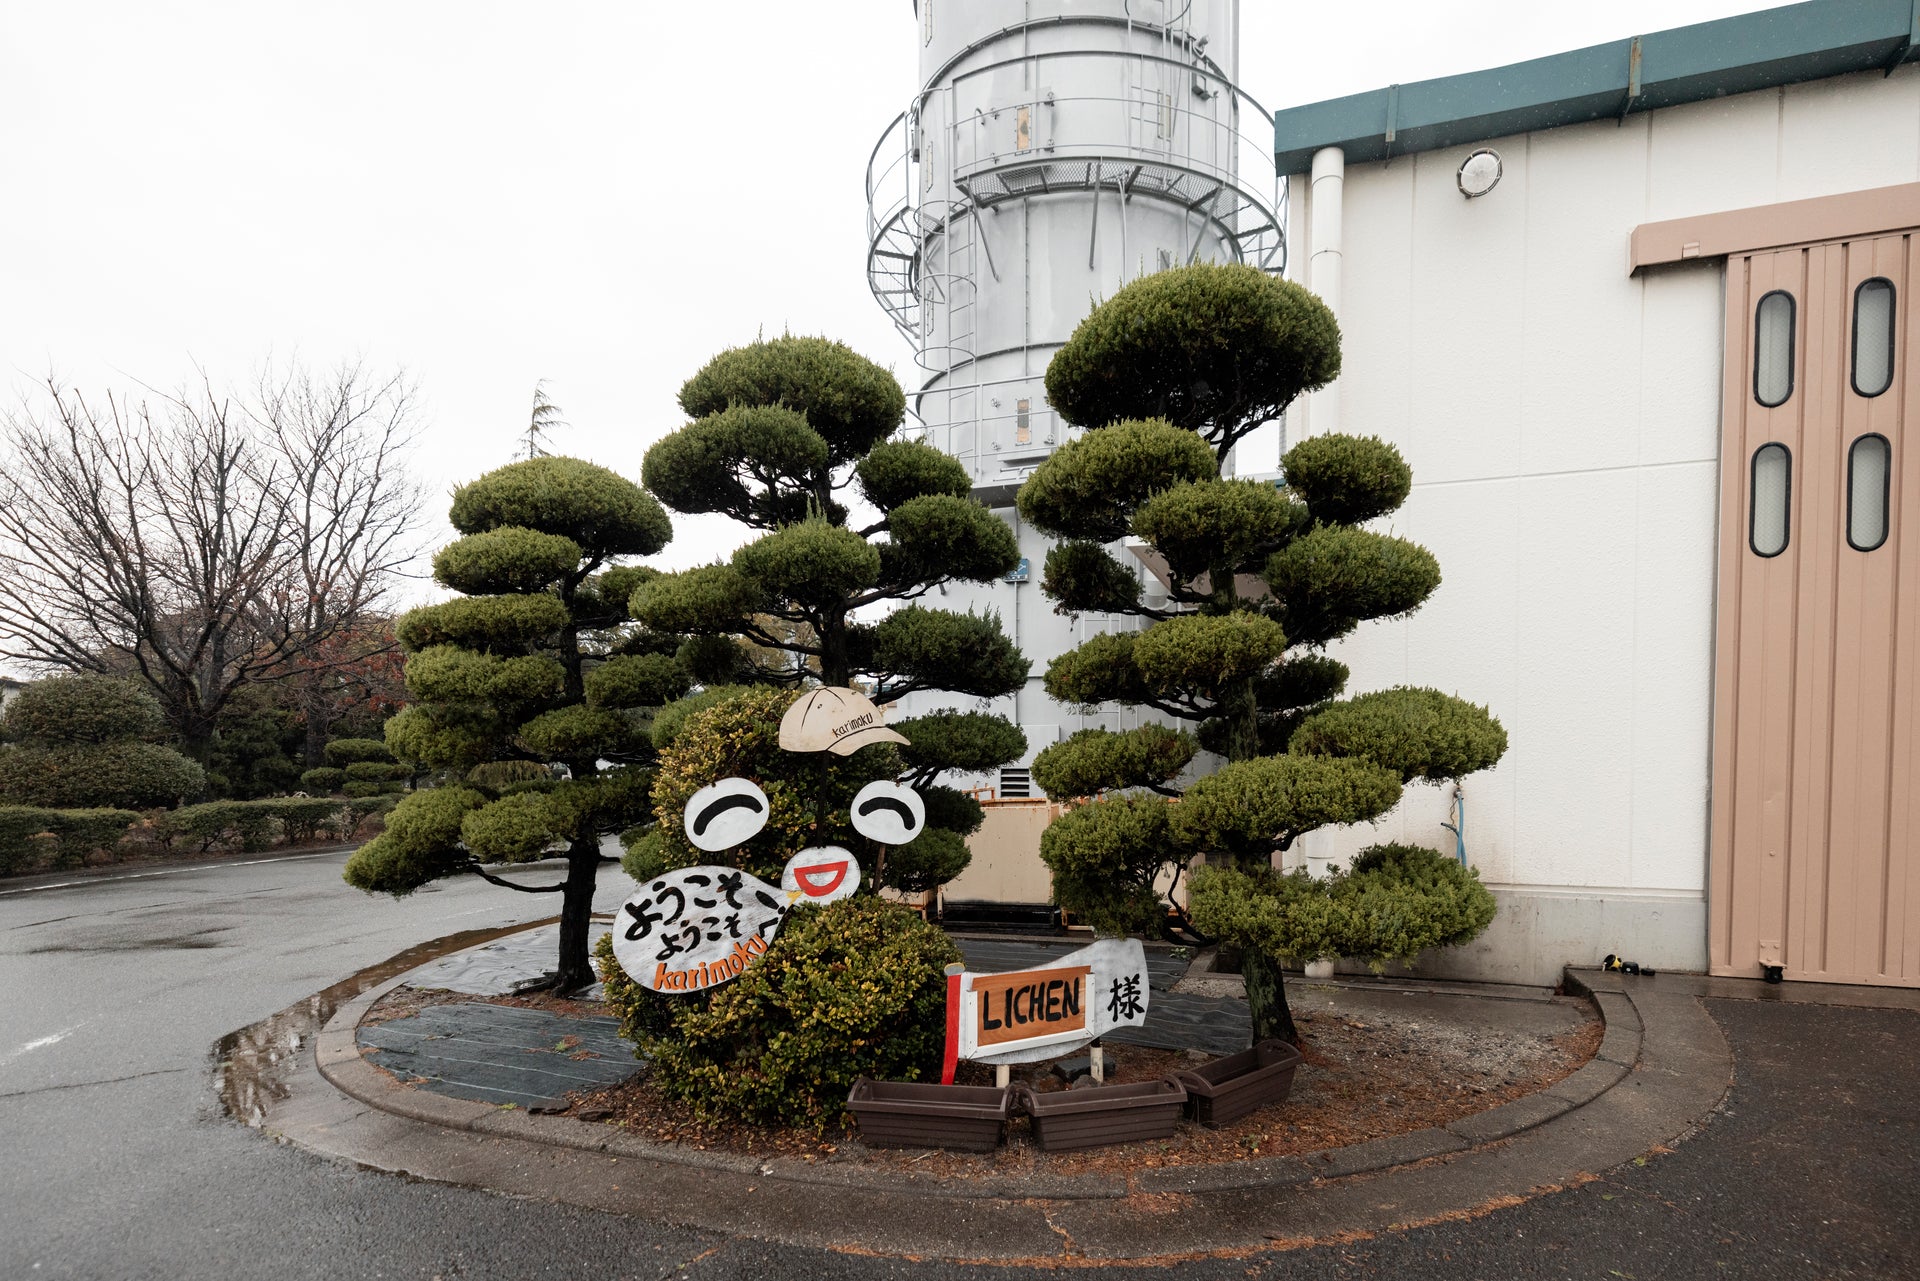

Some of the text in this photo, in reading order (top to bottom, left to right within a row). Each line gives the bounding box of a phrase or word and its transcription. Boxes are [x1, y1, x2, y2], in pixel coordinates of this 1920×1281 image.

[832, 712, 873, 738] karimoku
[653, 933, 769, 991] karimoku
[655, 912, 743, 961] ようこそ
[983, 973, 1145, 1030] LICHEN 様
